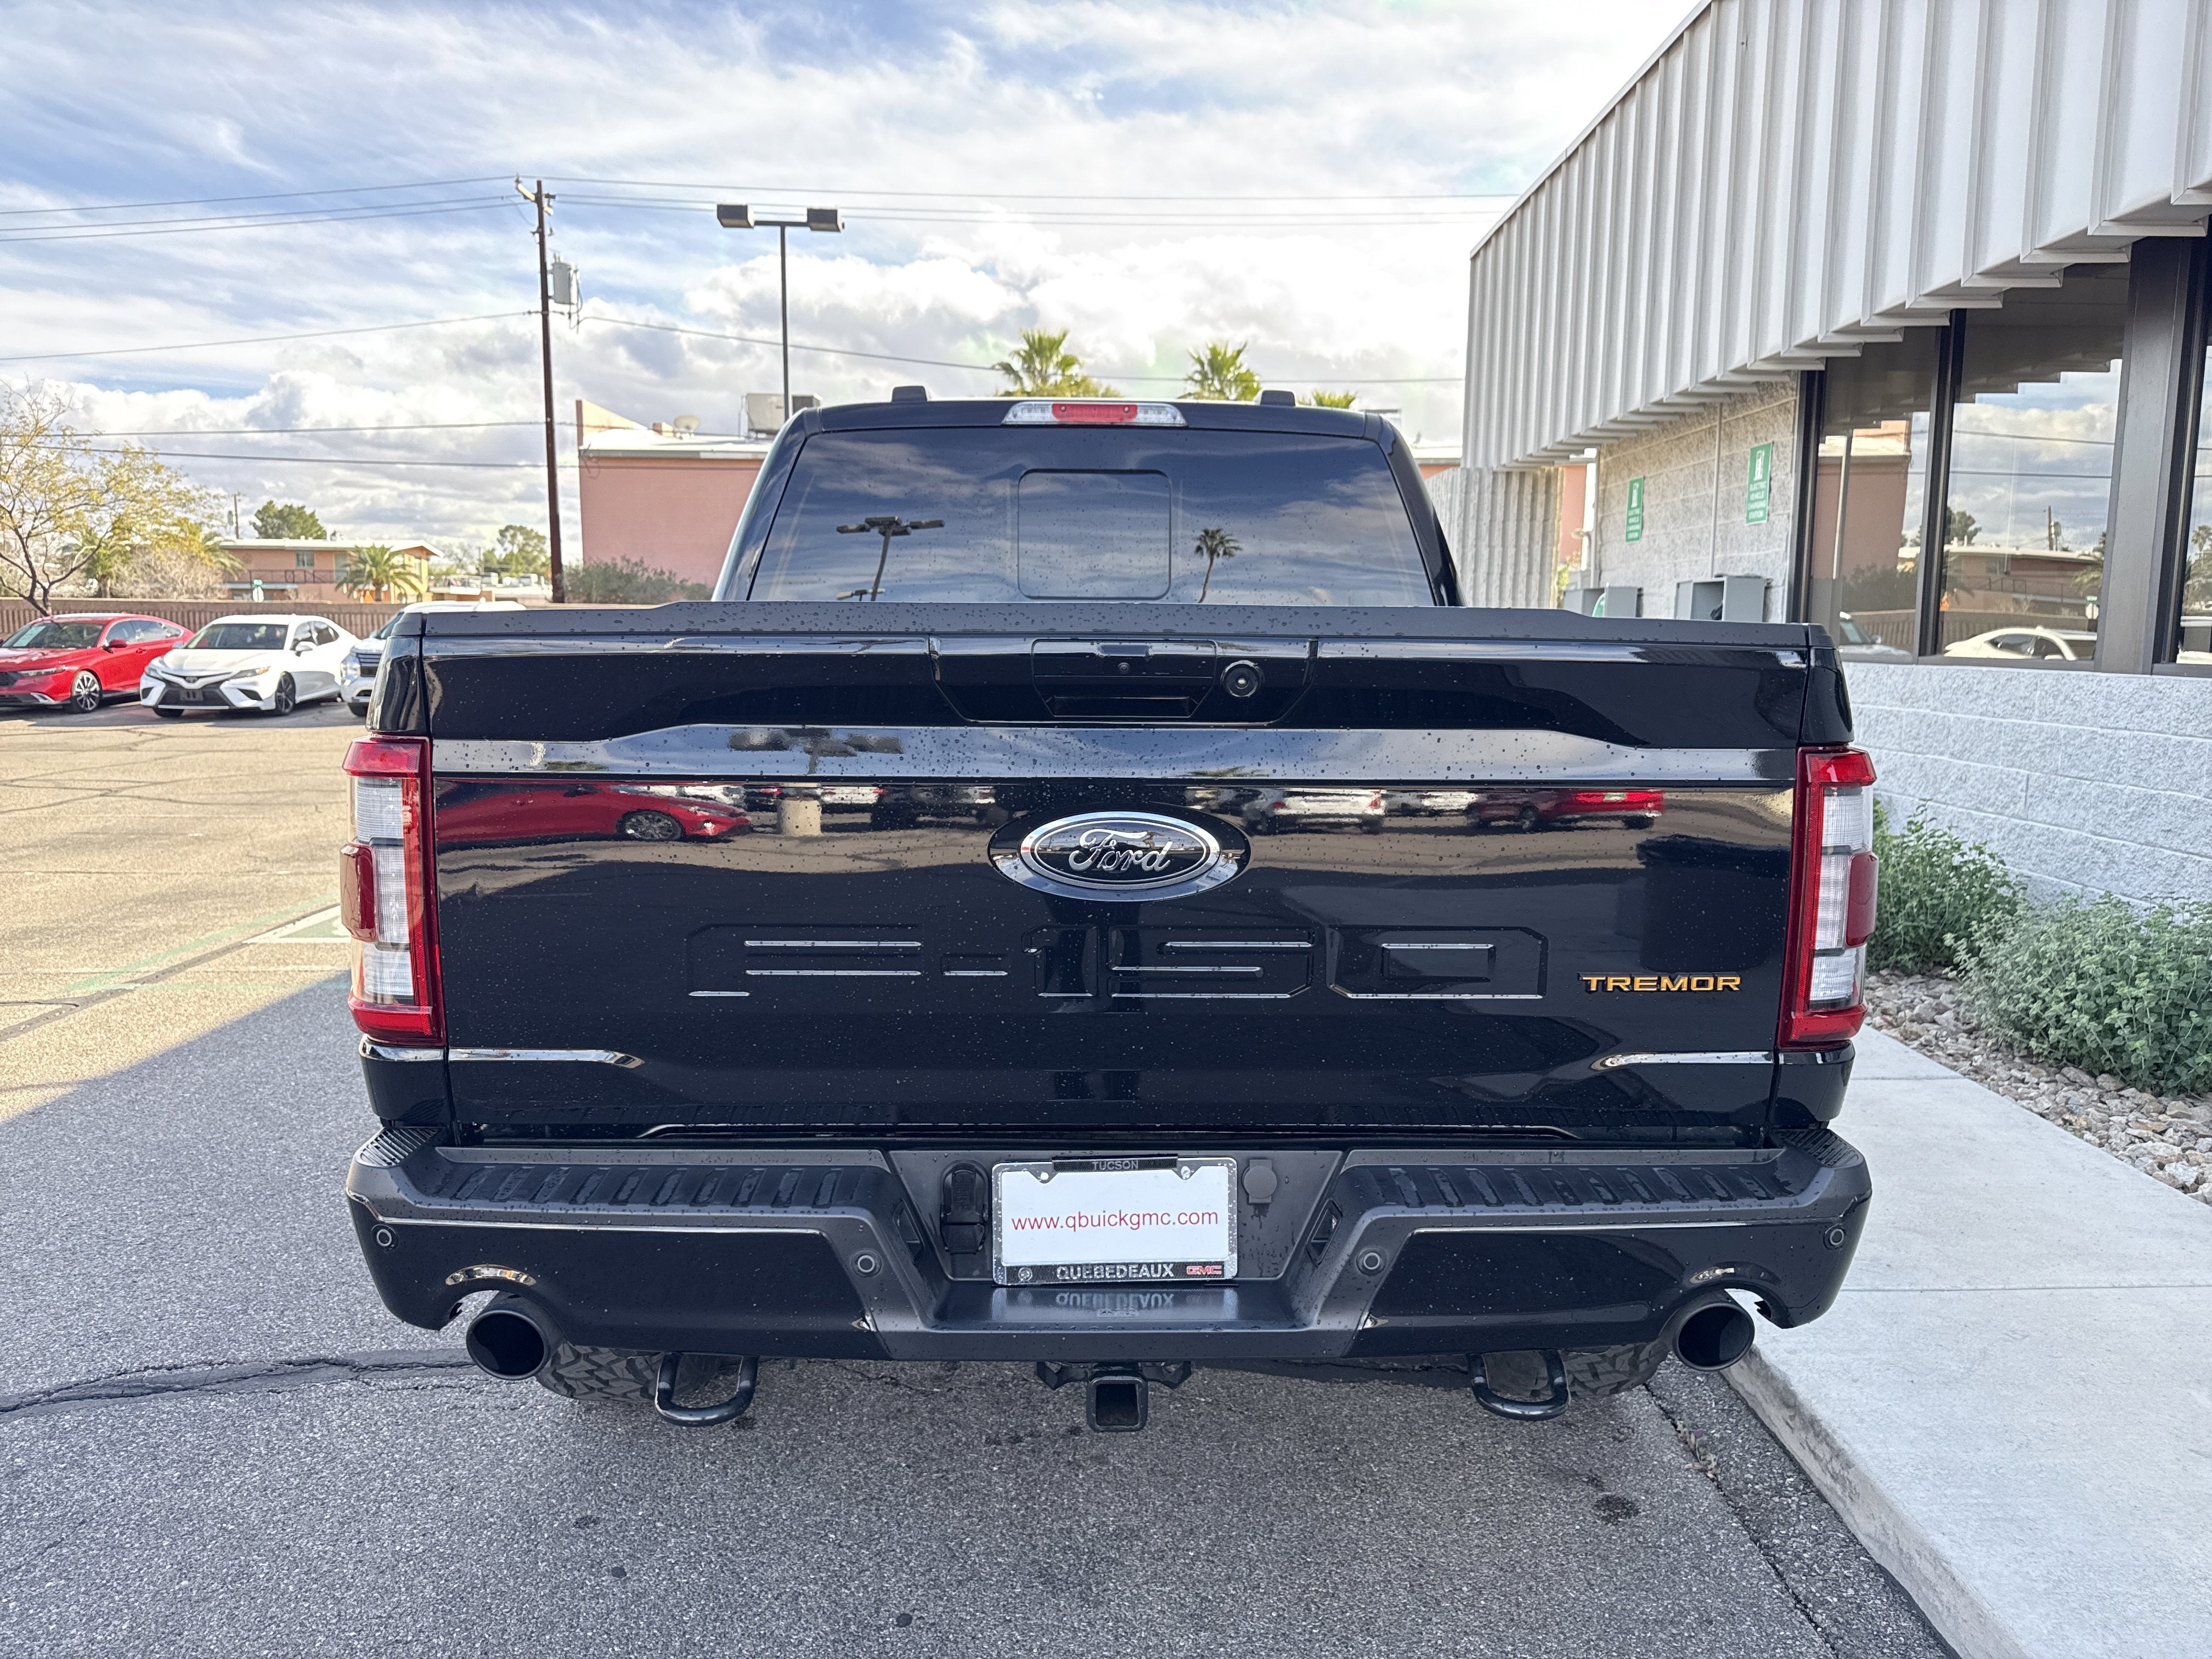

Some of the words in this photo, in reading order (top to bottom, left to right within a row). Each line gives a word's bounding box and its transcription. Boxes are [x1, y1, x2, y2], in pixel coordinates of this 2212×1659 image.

[1068, 828, 1173, 872] Ford
[1580, 974, 1741, 991] TREMOR
[1091, 1160, 1139, 1170] TUCSON
[1011, 1210, 1218, 1232] www.qbuickgmc.com
[1056, 1263, 1175, 1280] QUEBEDEAUX
[1186, 1265, 1222, 1276] GMC
